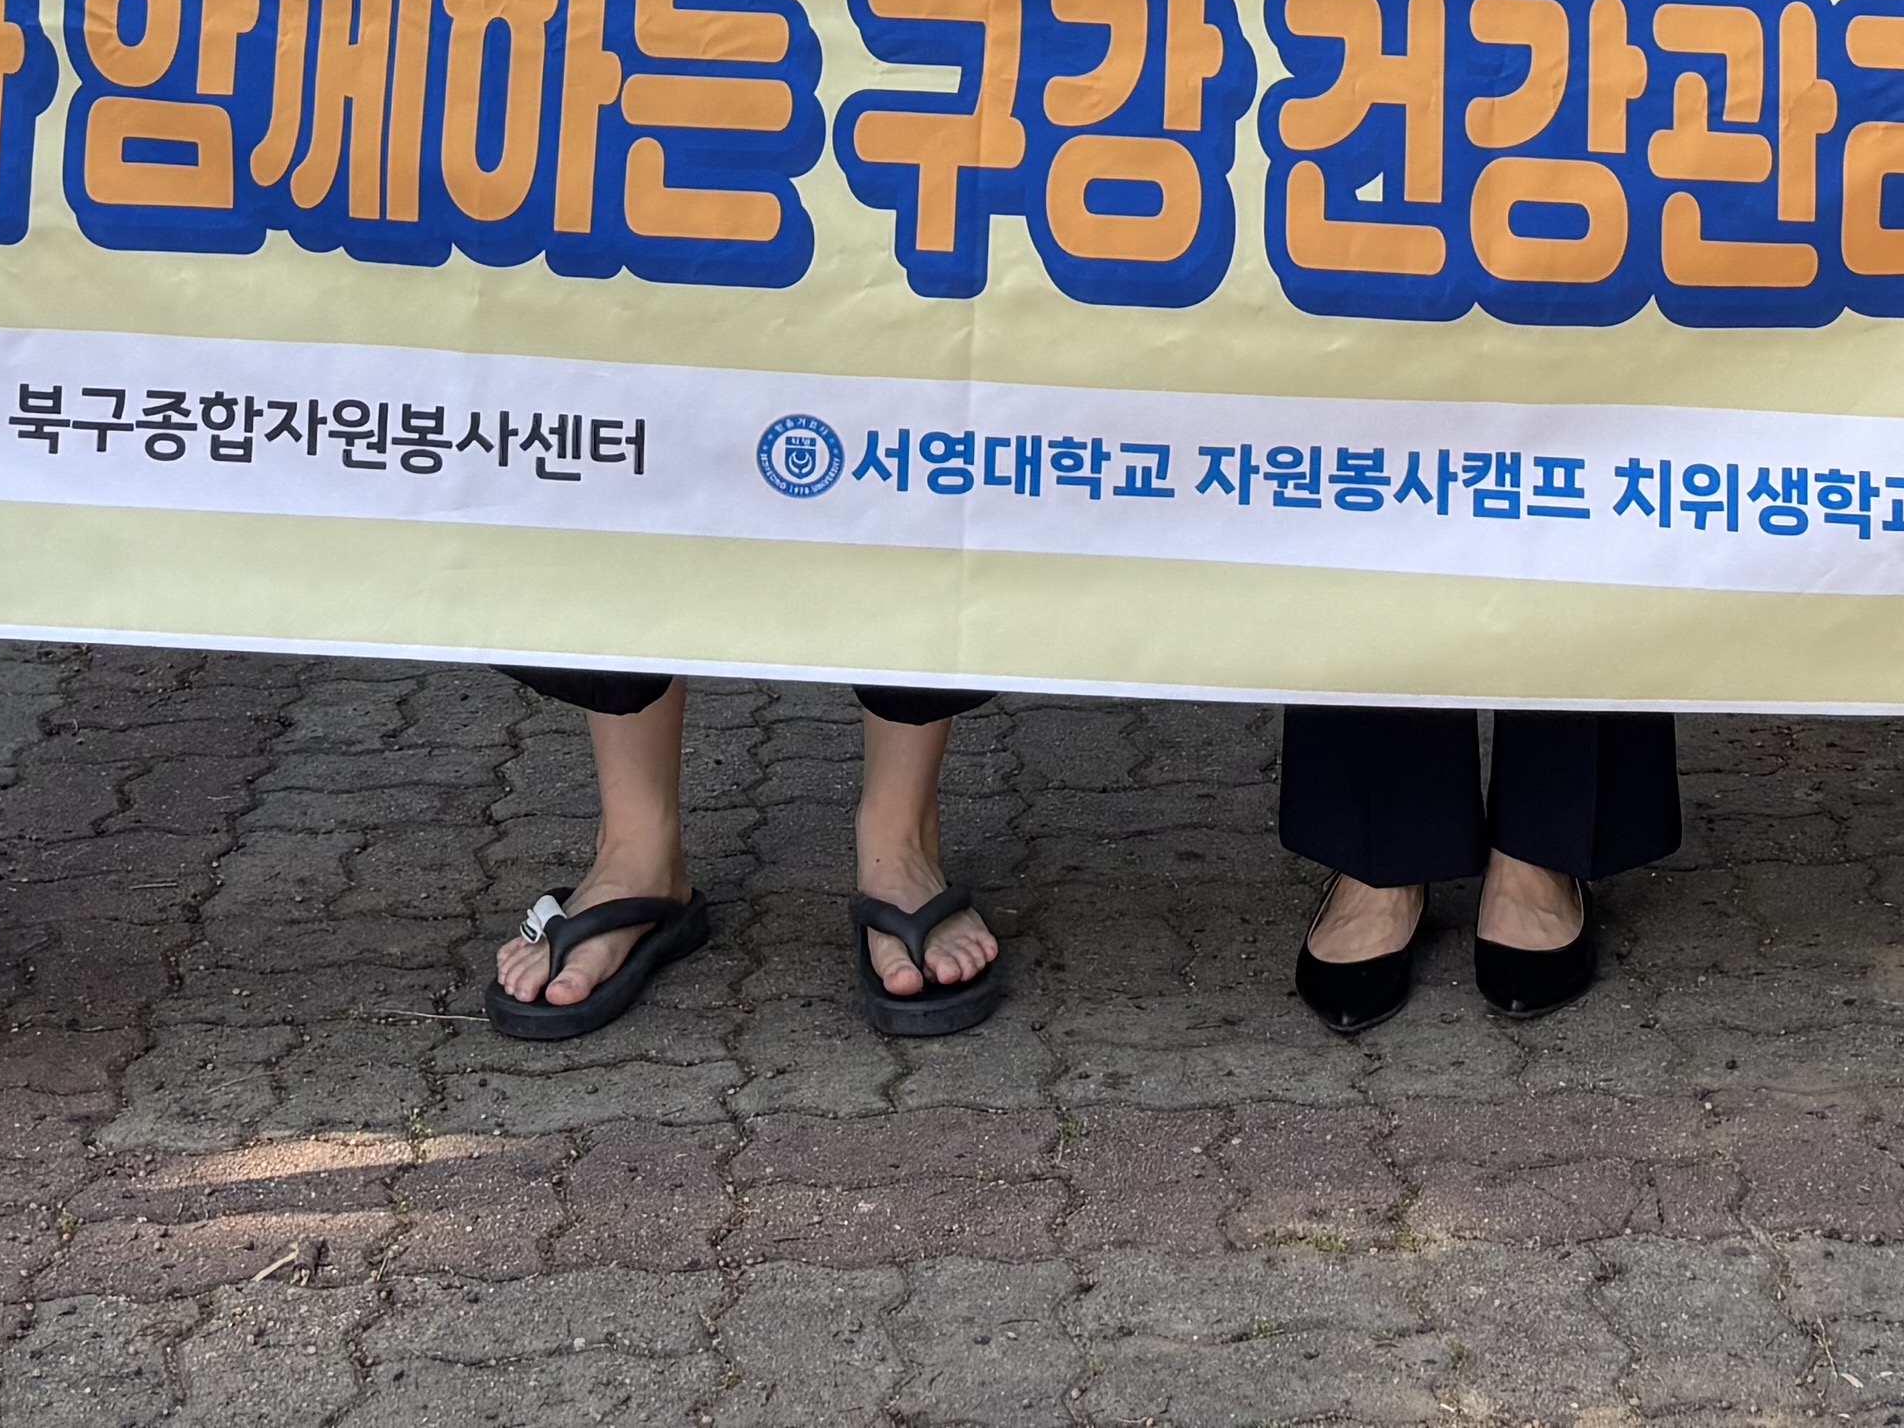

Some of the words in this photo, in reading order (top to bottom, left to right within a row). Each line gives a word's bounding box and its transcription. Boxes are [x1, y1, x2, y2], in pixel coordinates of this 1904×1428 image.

[8, 383, 646, 482] 북구종합자원봉사센터
[851, 428, 1175, 500] 서영대학교
[1195, 444, 1591, 520] 자원봉사캠프
